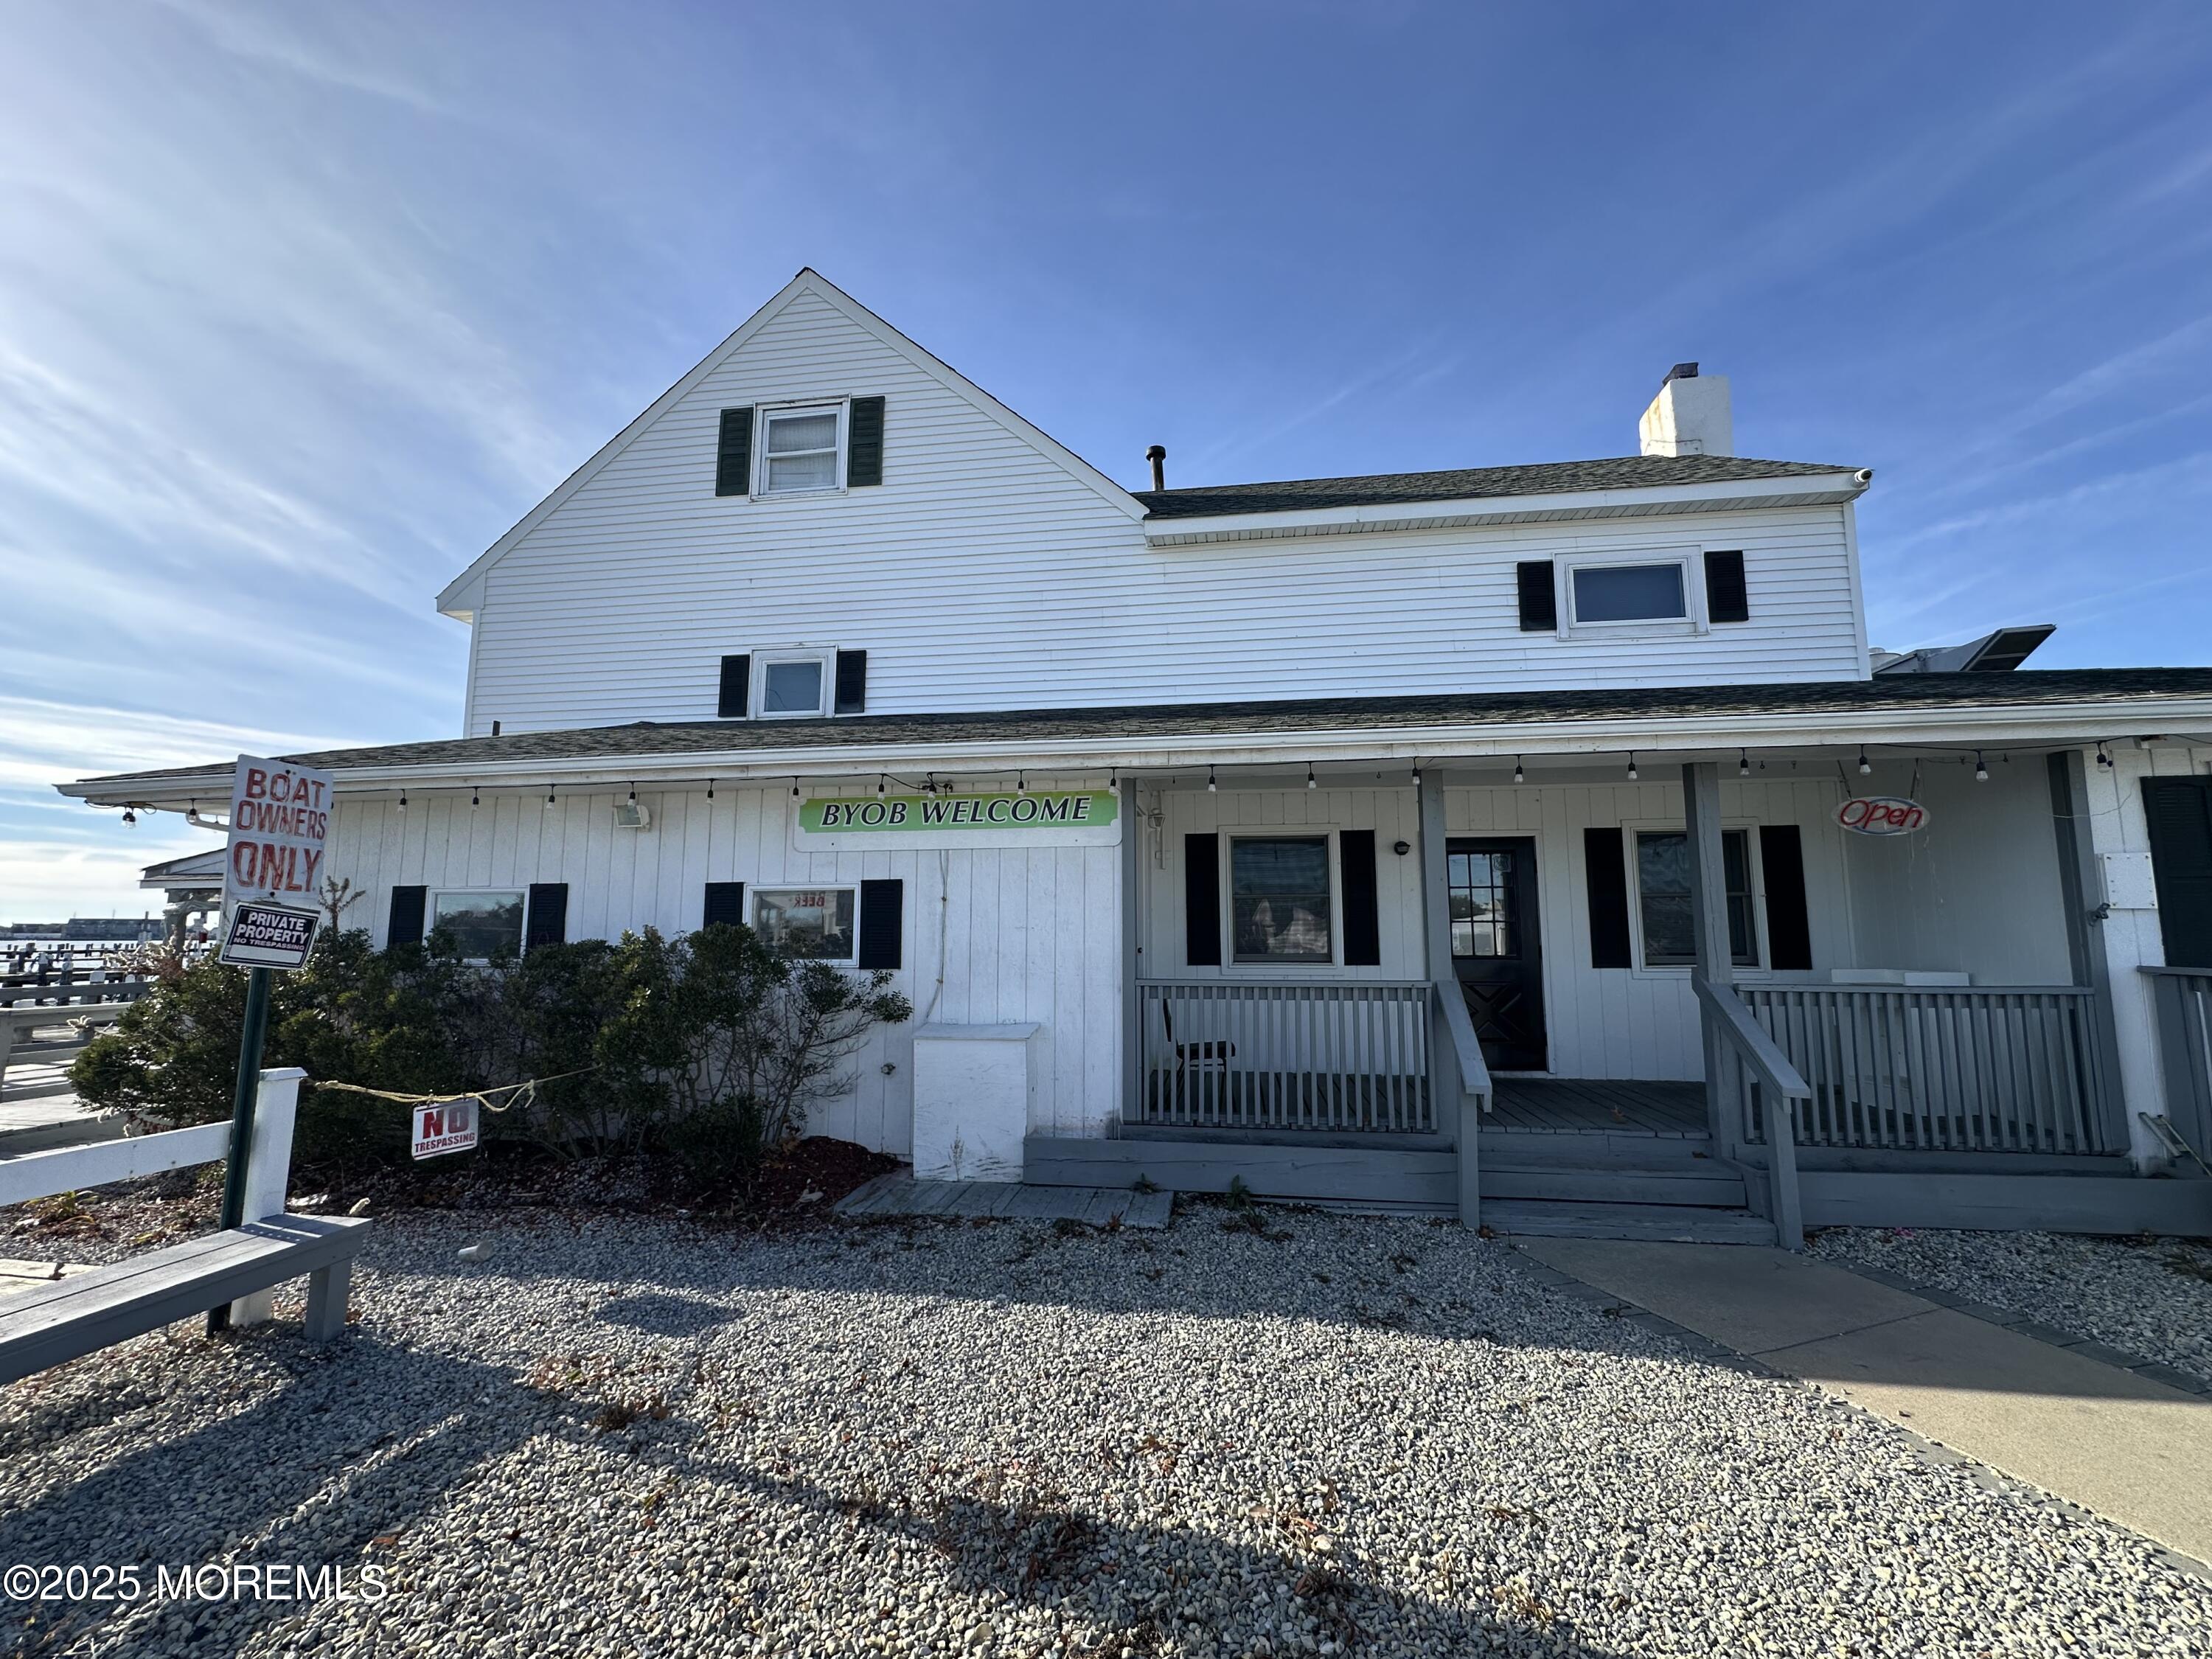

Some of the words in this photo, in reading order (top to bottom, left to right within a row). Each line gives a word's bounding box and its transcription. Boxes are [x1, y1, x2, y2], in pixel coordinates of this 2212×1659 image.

[246, 768, 325, 808] BOAT
[236, 800, 327, 840] OWNERS
[821, 801, 908, 827] BYOB
[922, 796, 1092, 824] WELCOME
[1840, 799, 1923, 829] Open
[233, 841, 322, 892] ONLY
[235, 924, 309, 944] PROPERTY
[248, 912, 307, 931] PRIVATE
[249, 939, 305, 950] TRESPASSING
[422, 1106, 470, 1139] NO
[414, 1132, 476, 1152] TRESPASSING
